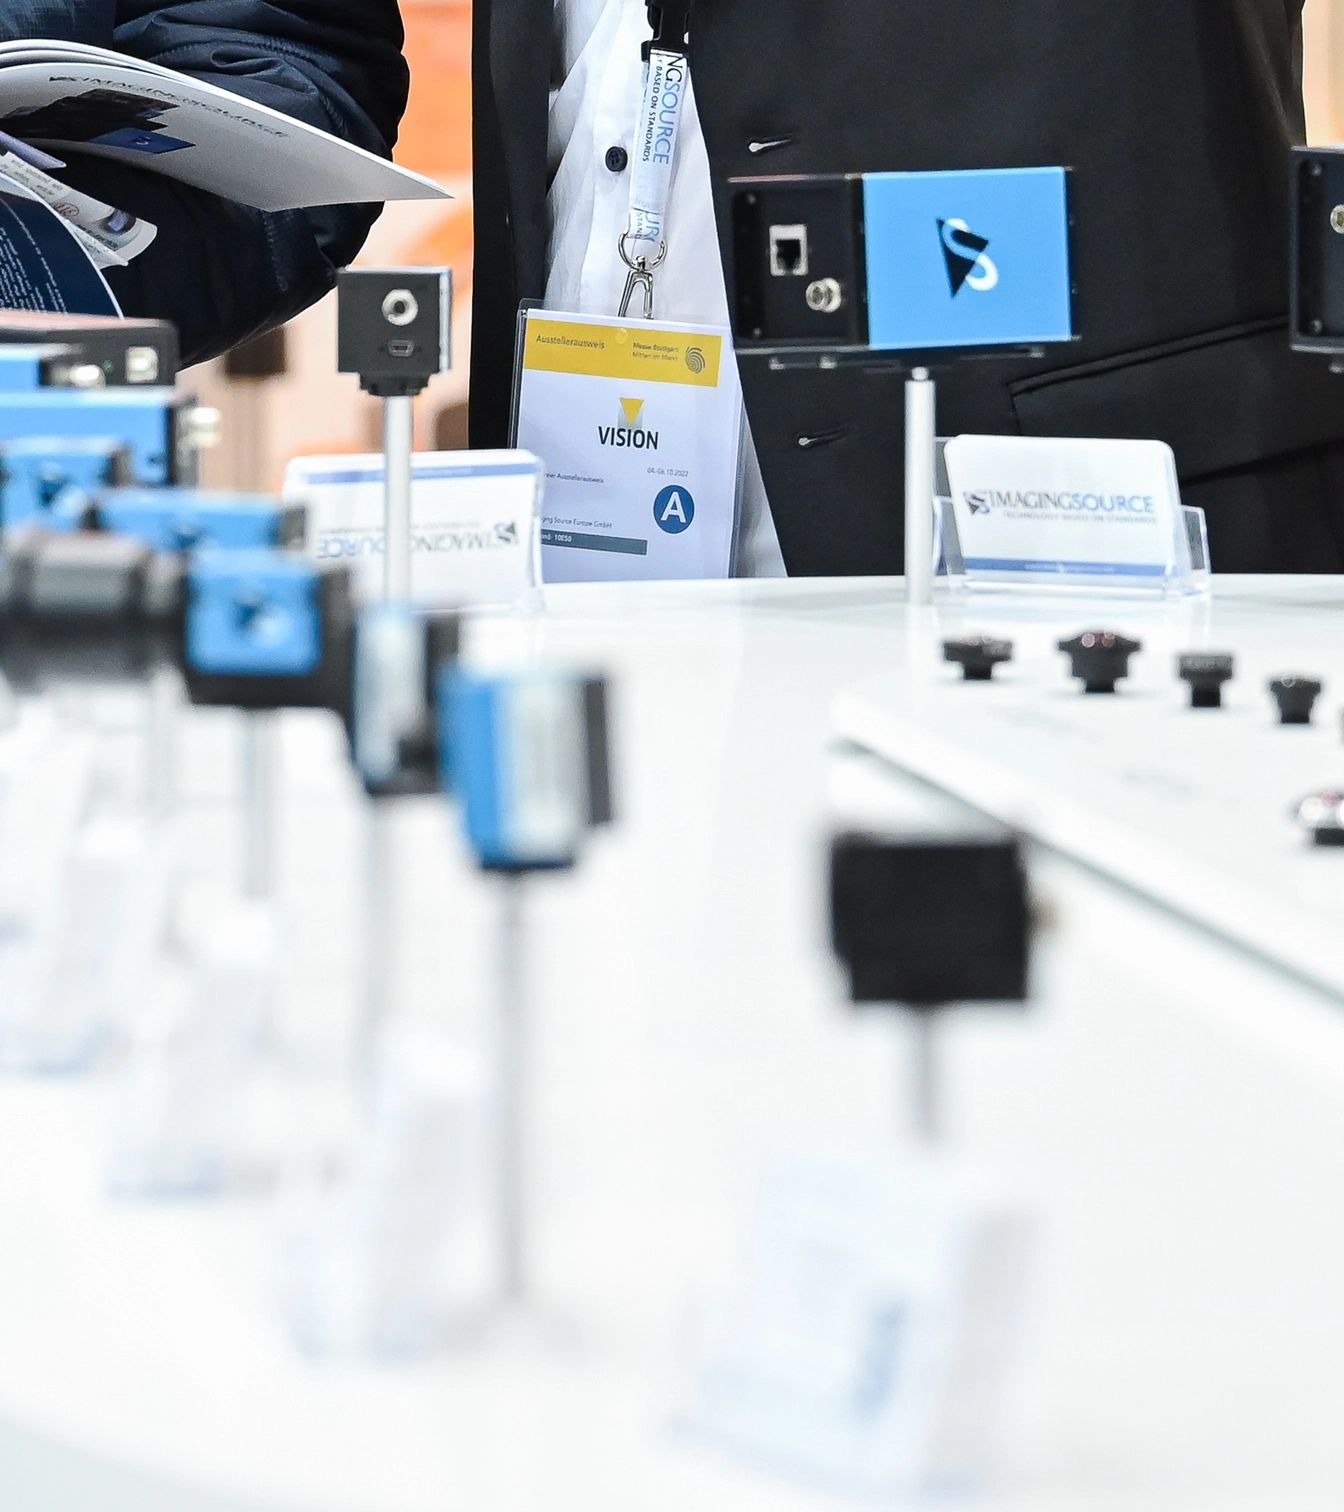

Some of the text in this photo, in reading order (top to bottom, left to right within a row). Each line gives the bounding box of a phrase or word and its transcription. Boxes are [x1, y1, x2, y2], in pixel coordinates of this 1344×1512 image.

[652, 66, 663, 93] BASED
[650, 96, 657, 109] ON
[642, 112, 656, 162] STANDARDS
[536, 334, 605, 349] Ausstellerausweis
[598, 426, 659, 450] VISION
[660, 490, 687, 524] A
[988, 490, 1155, 514] IMAGINGSOURCE
